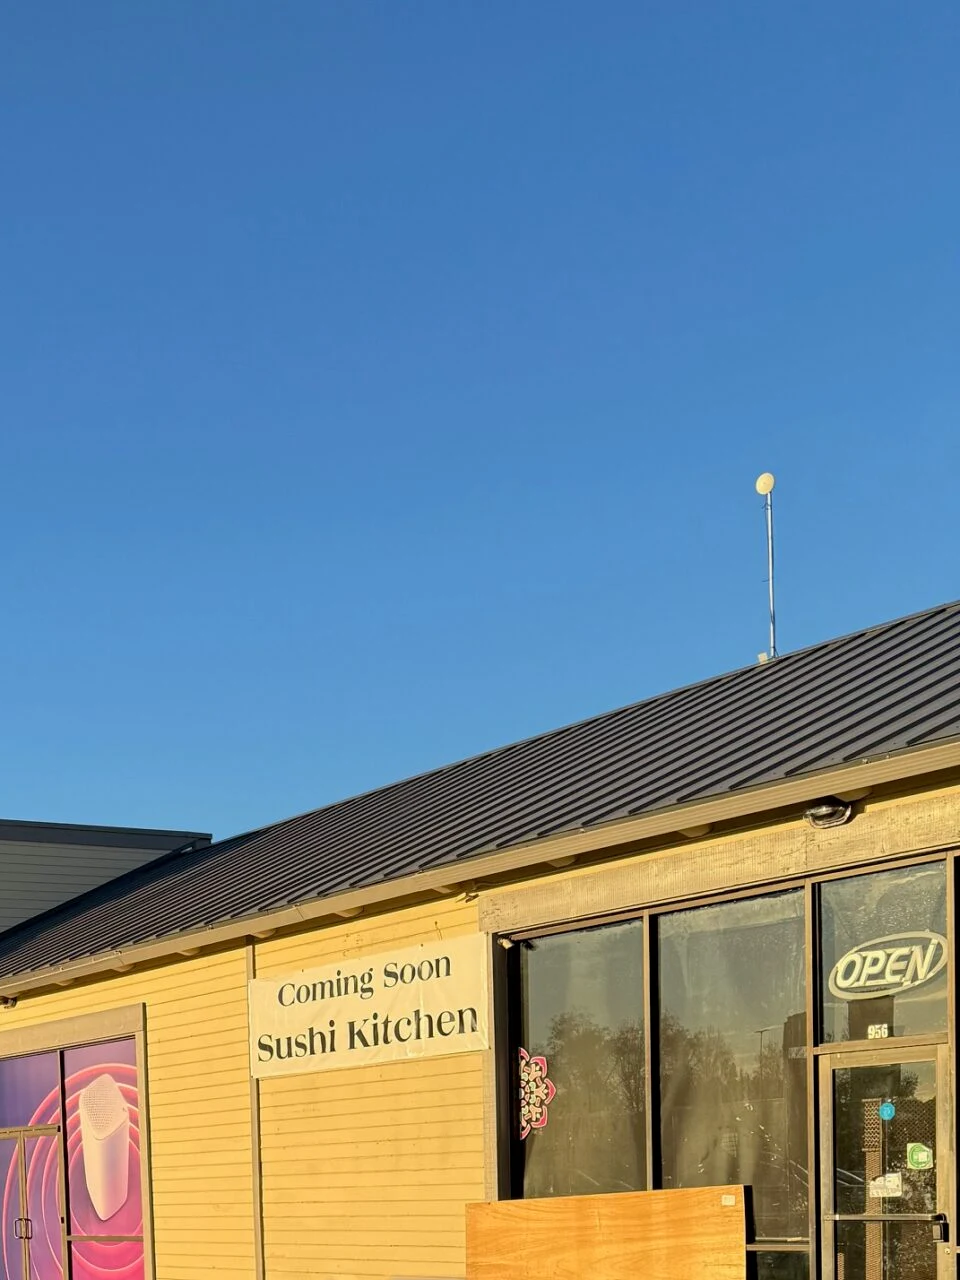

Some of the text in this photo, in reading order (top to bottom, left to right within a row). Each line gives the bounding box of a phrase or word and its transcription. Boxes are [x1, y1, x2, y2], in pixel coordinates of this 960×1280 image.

[277, 955, 452, 1007] Coming Soon
[836, 939, 938, 989] OPEN
[257, 1007, 478, 1062] Sushi Kitchen
[867, 1024, 888, 1039] 956
